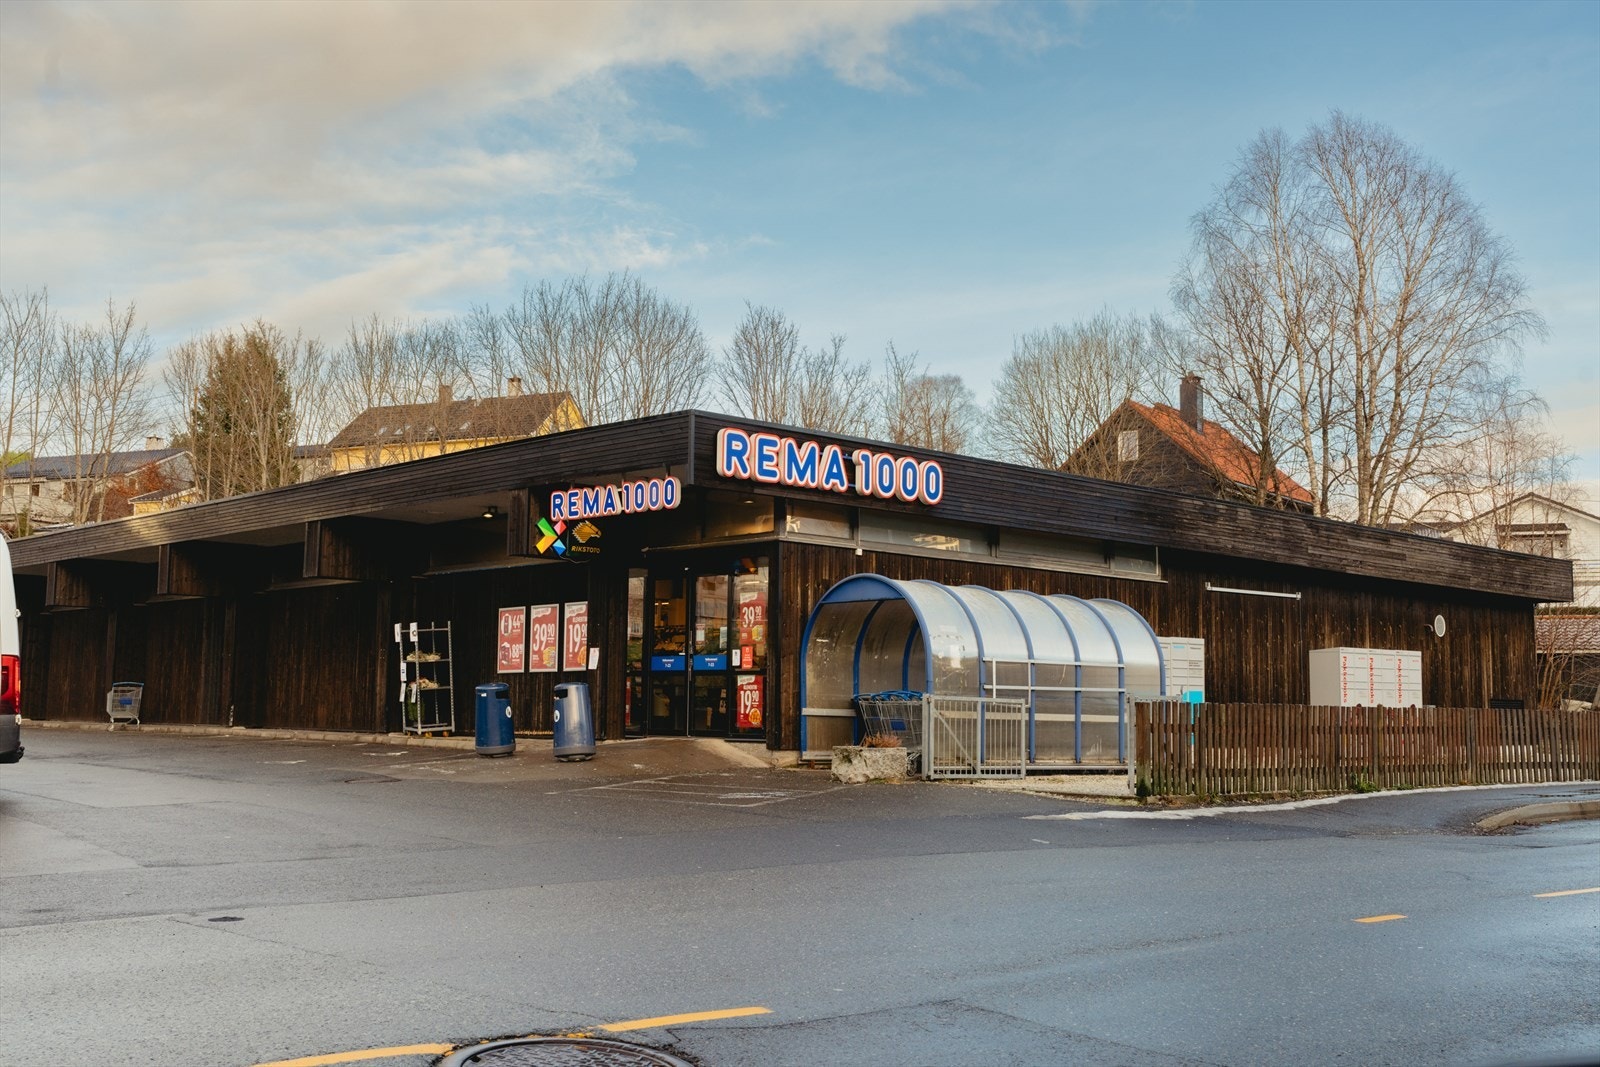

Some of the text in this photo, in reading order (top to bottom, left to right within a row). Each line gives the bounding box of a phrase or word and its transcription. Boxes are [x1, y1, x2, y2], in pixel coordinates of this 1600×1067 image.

[716, 427, 943, 505] REMA 1000
[550, 476, 681, 522] REMA 1000
[571, 545, 601, 554] RIKSTOTO
[742, 606, 754, 628] 39
[533, 623, 555, 652] 39 90
[568, 623, 581, 653] 19
[740, 691, 752, 714] 19
